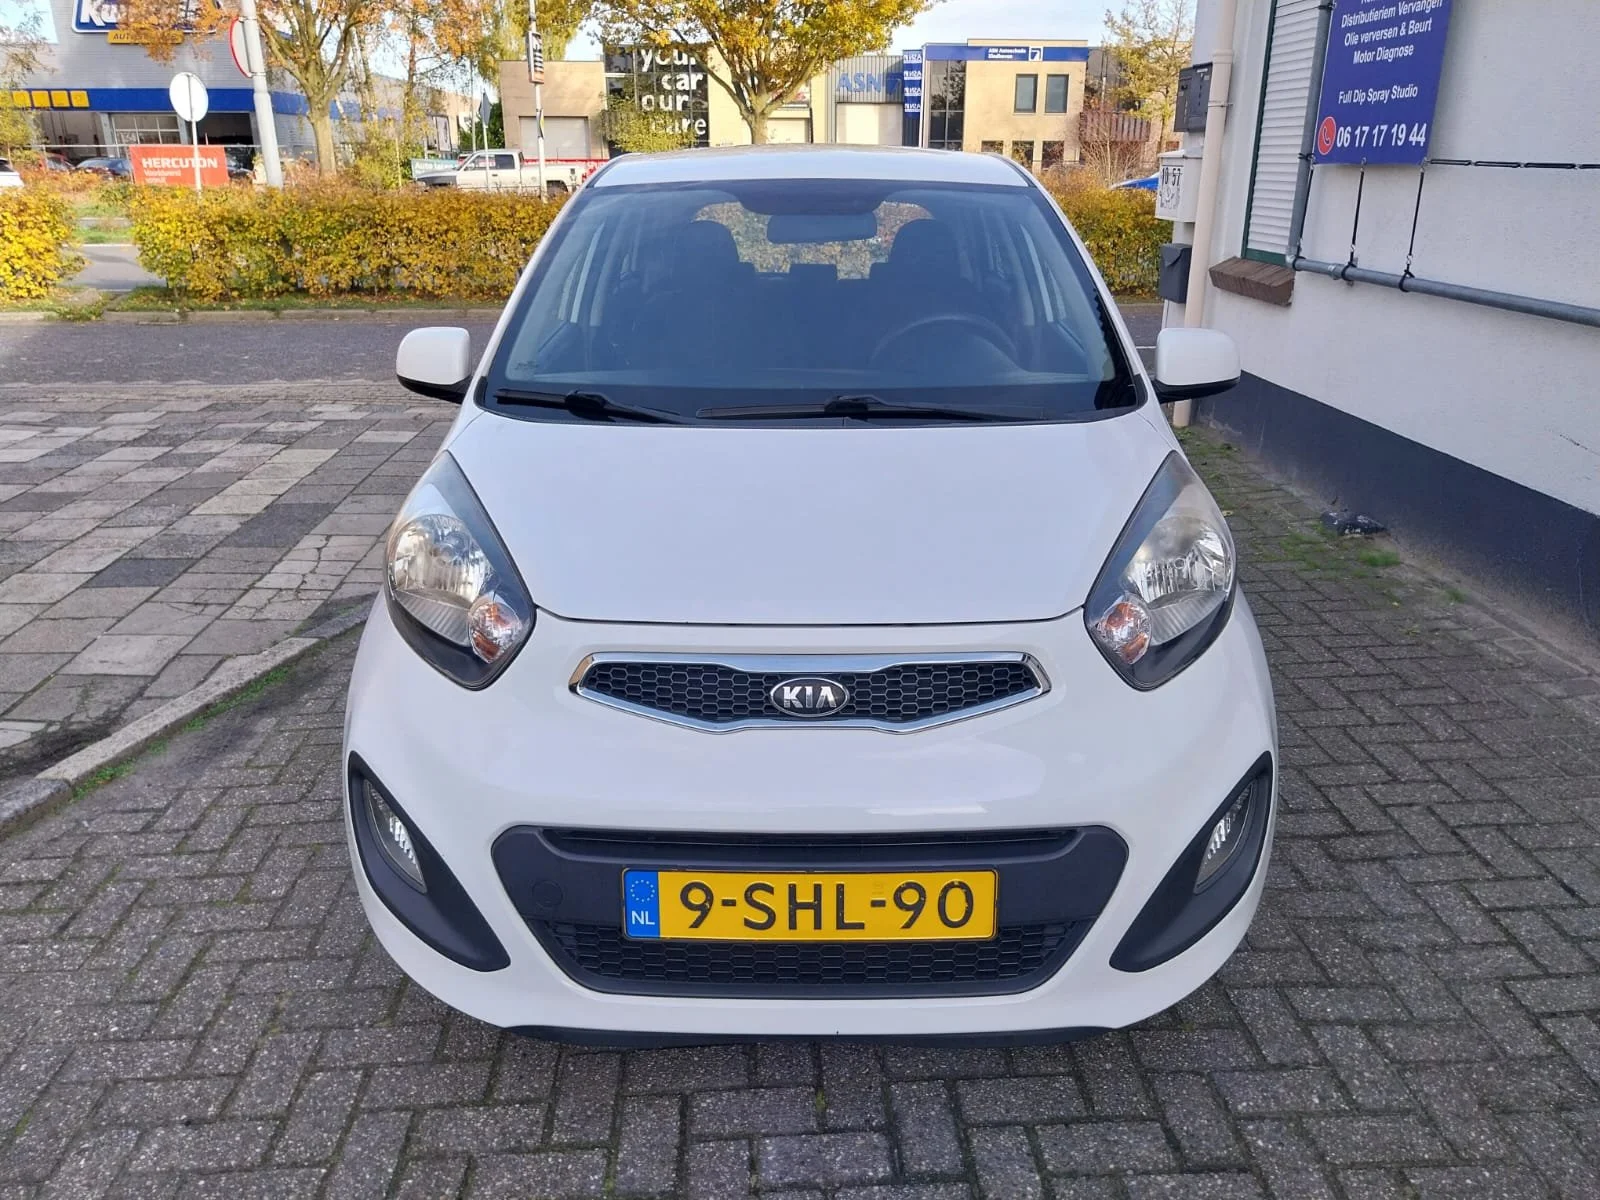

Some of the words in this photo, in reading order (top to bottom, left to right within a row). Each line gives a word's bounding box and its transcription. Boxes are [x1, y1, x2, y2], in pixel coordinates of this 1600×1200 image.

[1341, 6, 1396, 28] Distributieriem
[1398, 0, 1443, 16] Vervangen
[1344, 31, 1359, 46] Olie
[1360, 26, 1398, 43] verversen
[1399, 21, 1407, 36] &
[1408, 17, 1433, 35] Beurt
[1353, 49, 1375, 64] Motor
[1376, 44, 1414, 62] Diagnose
[661, 72, 704, 91] car
[836, 72, 882, 93] ASN
[641, 94, 690, 112] our
[1338, 90, 1352, 104] Full
[1353, 89, 1366, 105] Dip
[1367, 88, 1391, 104] Spray
[1391, 83, 1418, 100] Studio
[1336, 126, 1352, 148] 06
[1354, 125, 1370, 148] 17
[1372, 124, 1388, 147] 17
[1391, 123, 1407, 146] 19
[1408, 123, 1427, 147] 44
[141, 157, 218, 169] HERCUTON
[782, 686, 837, 709] KIA
[679, 880, 975, 930] 9-SHL-90
[631, 910, 655, 926] NL
